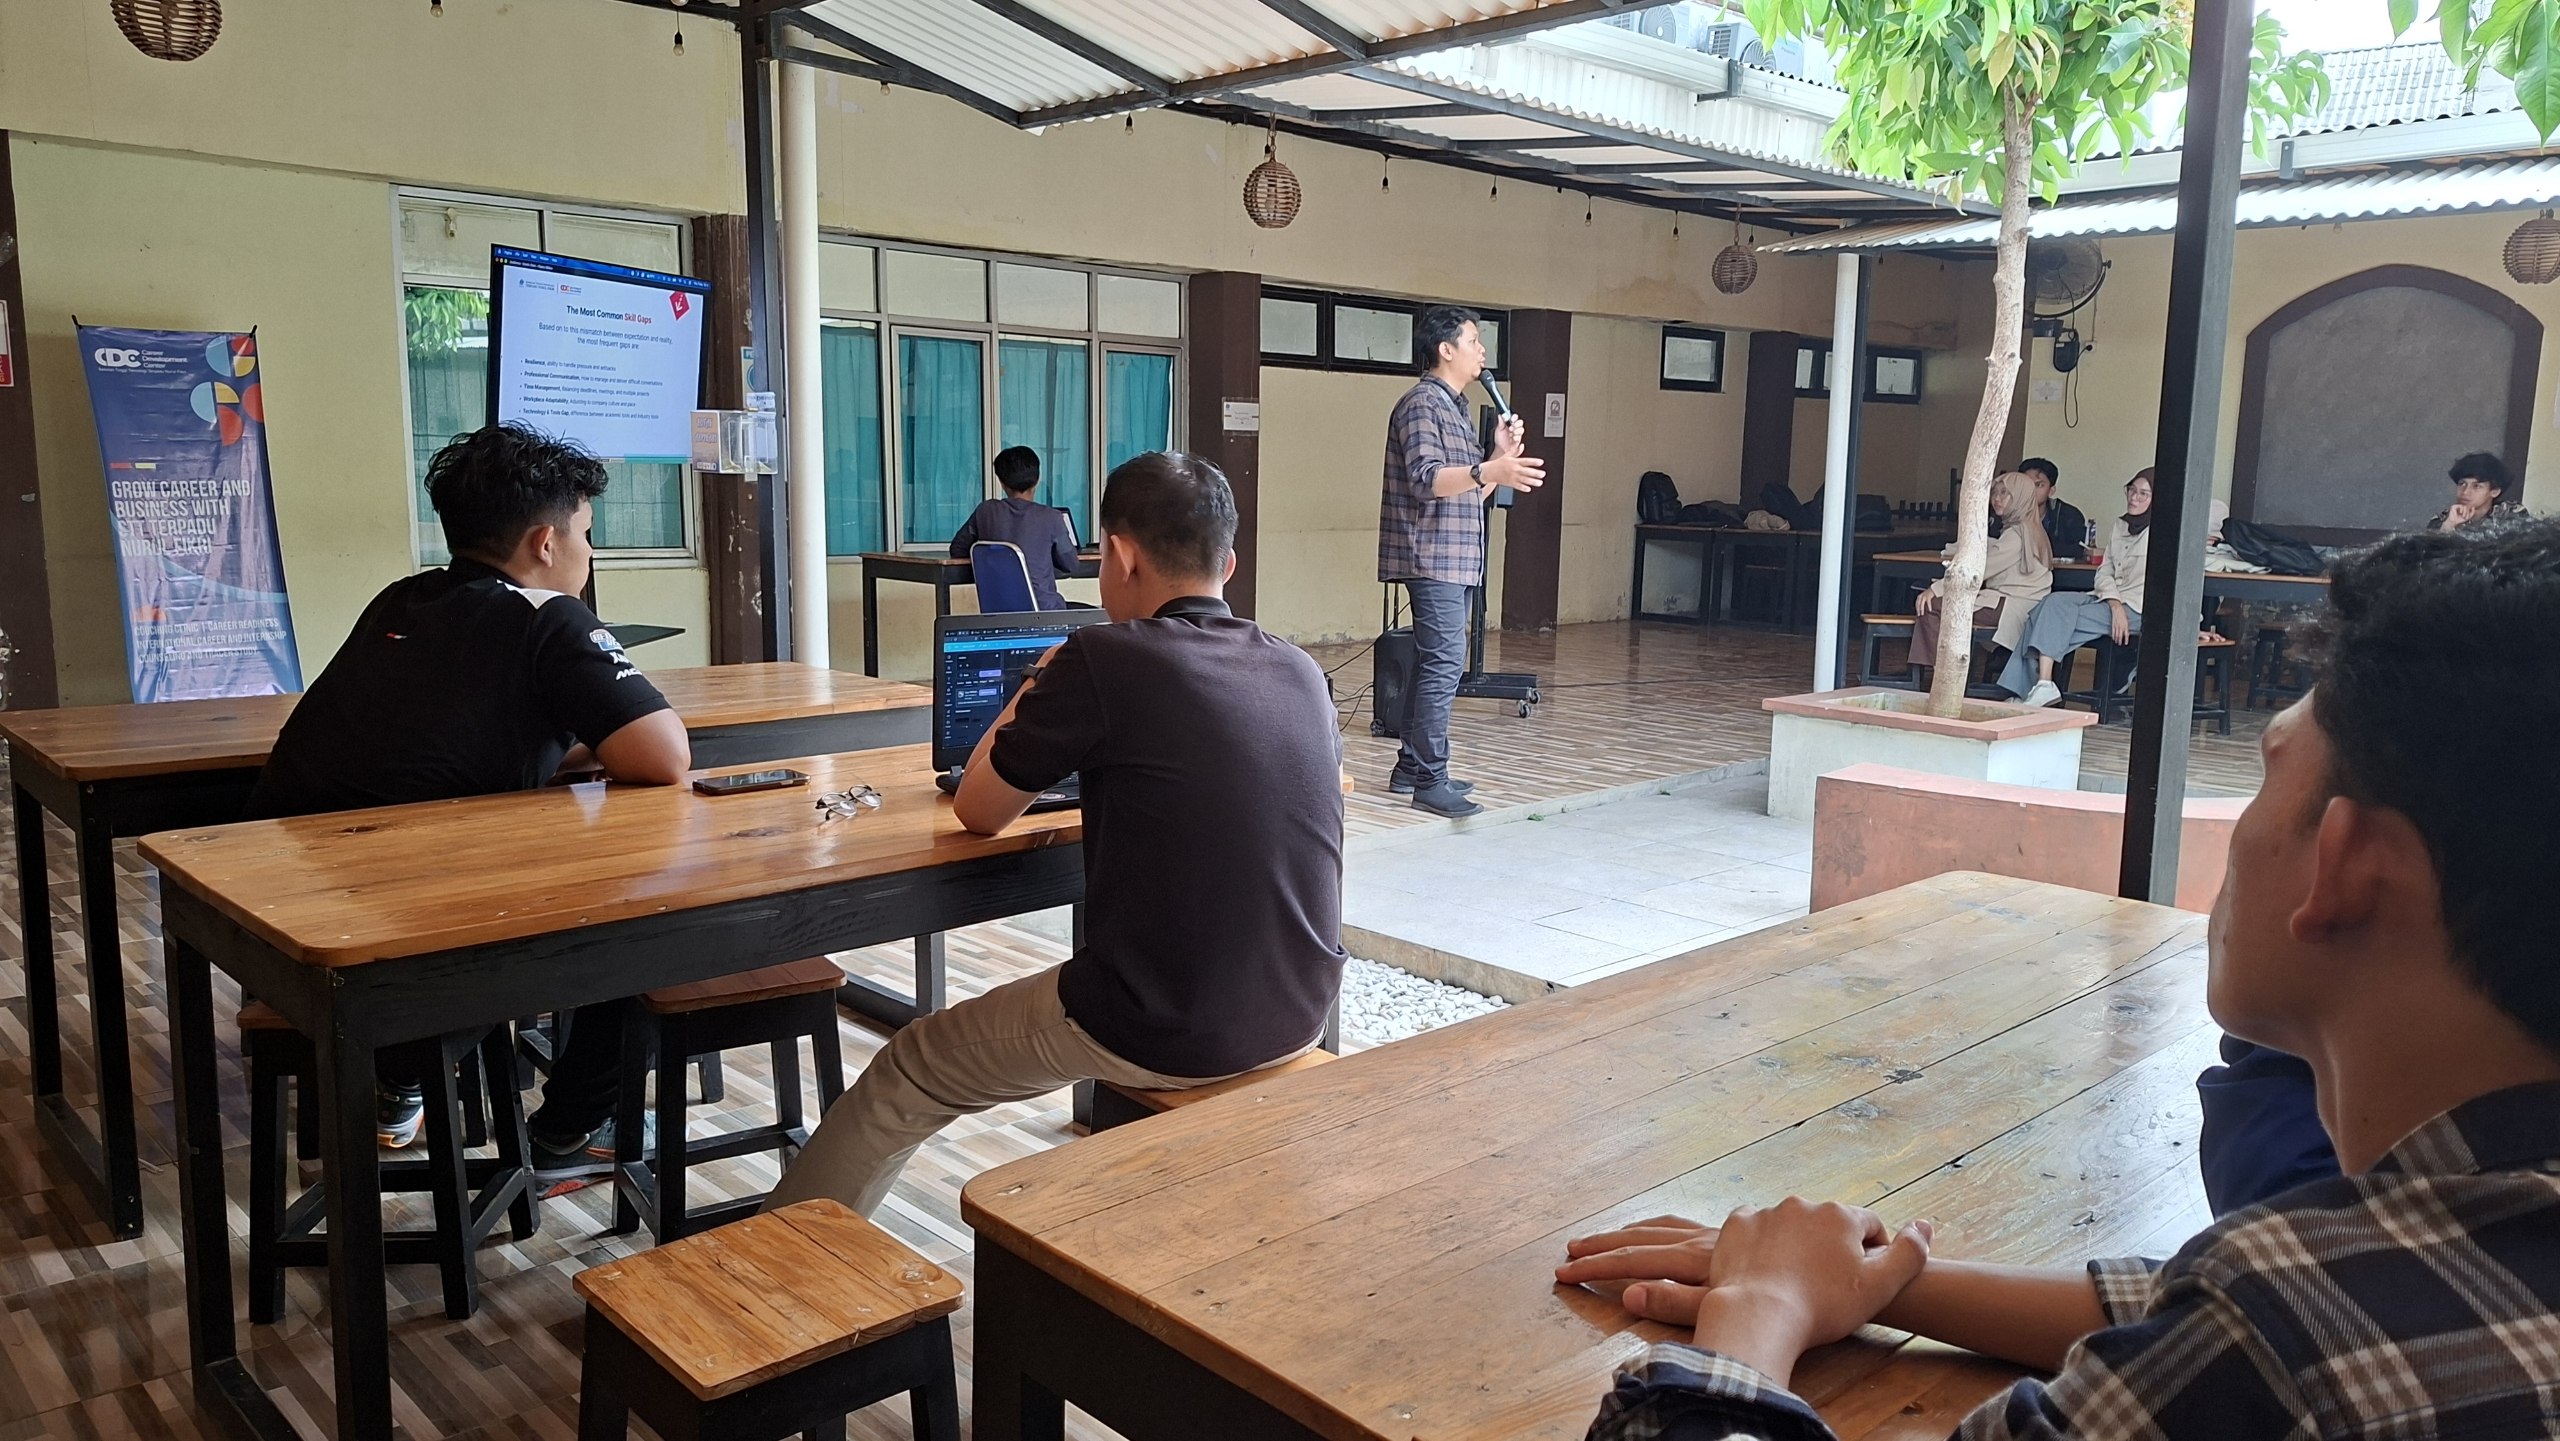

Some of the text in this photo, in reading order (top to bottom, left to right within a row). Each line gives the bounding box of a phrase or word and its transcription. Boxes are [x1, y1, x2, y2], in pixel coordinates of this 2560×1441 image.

[566, 304, 652, 325] The Most Common Skill Gaps
[539, 322, 555, 331] Based
[604, 330, 623, 338] between
[94, 347, 141, 368] CDC
[112, 479, 251, 498] GROW CAREER AND
[115, 499, 230, 518] BUSINESS WITH
[119, 518, 216, 538] STT TERPADU
[121, 538, 167, 557] NURUL
[208, 620, 238, 632] CAREER
[239, 618, 280, 630] READINESS
[196, 634, 226, 646] CAREER
